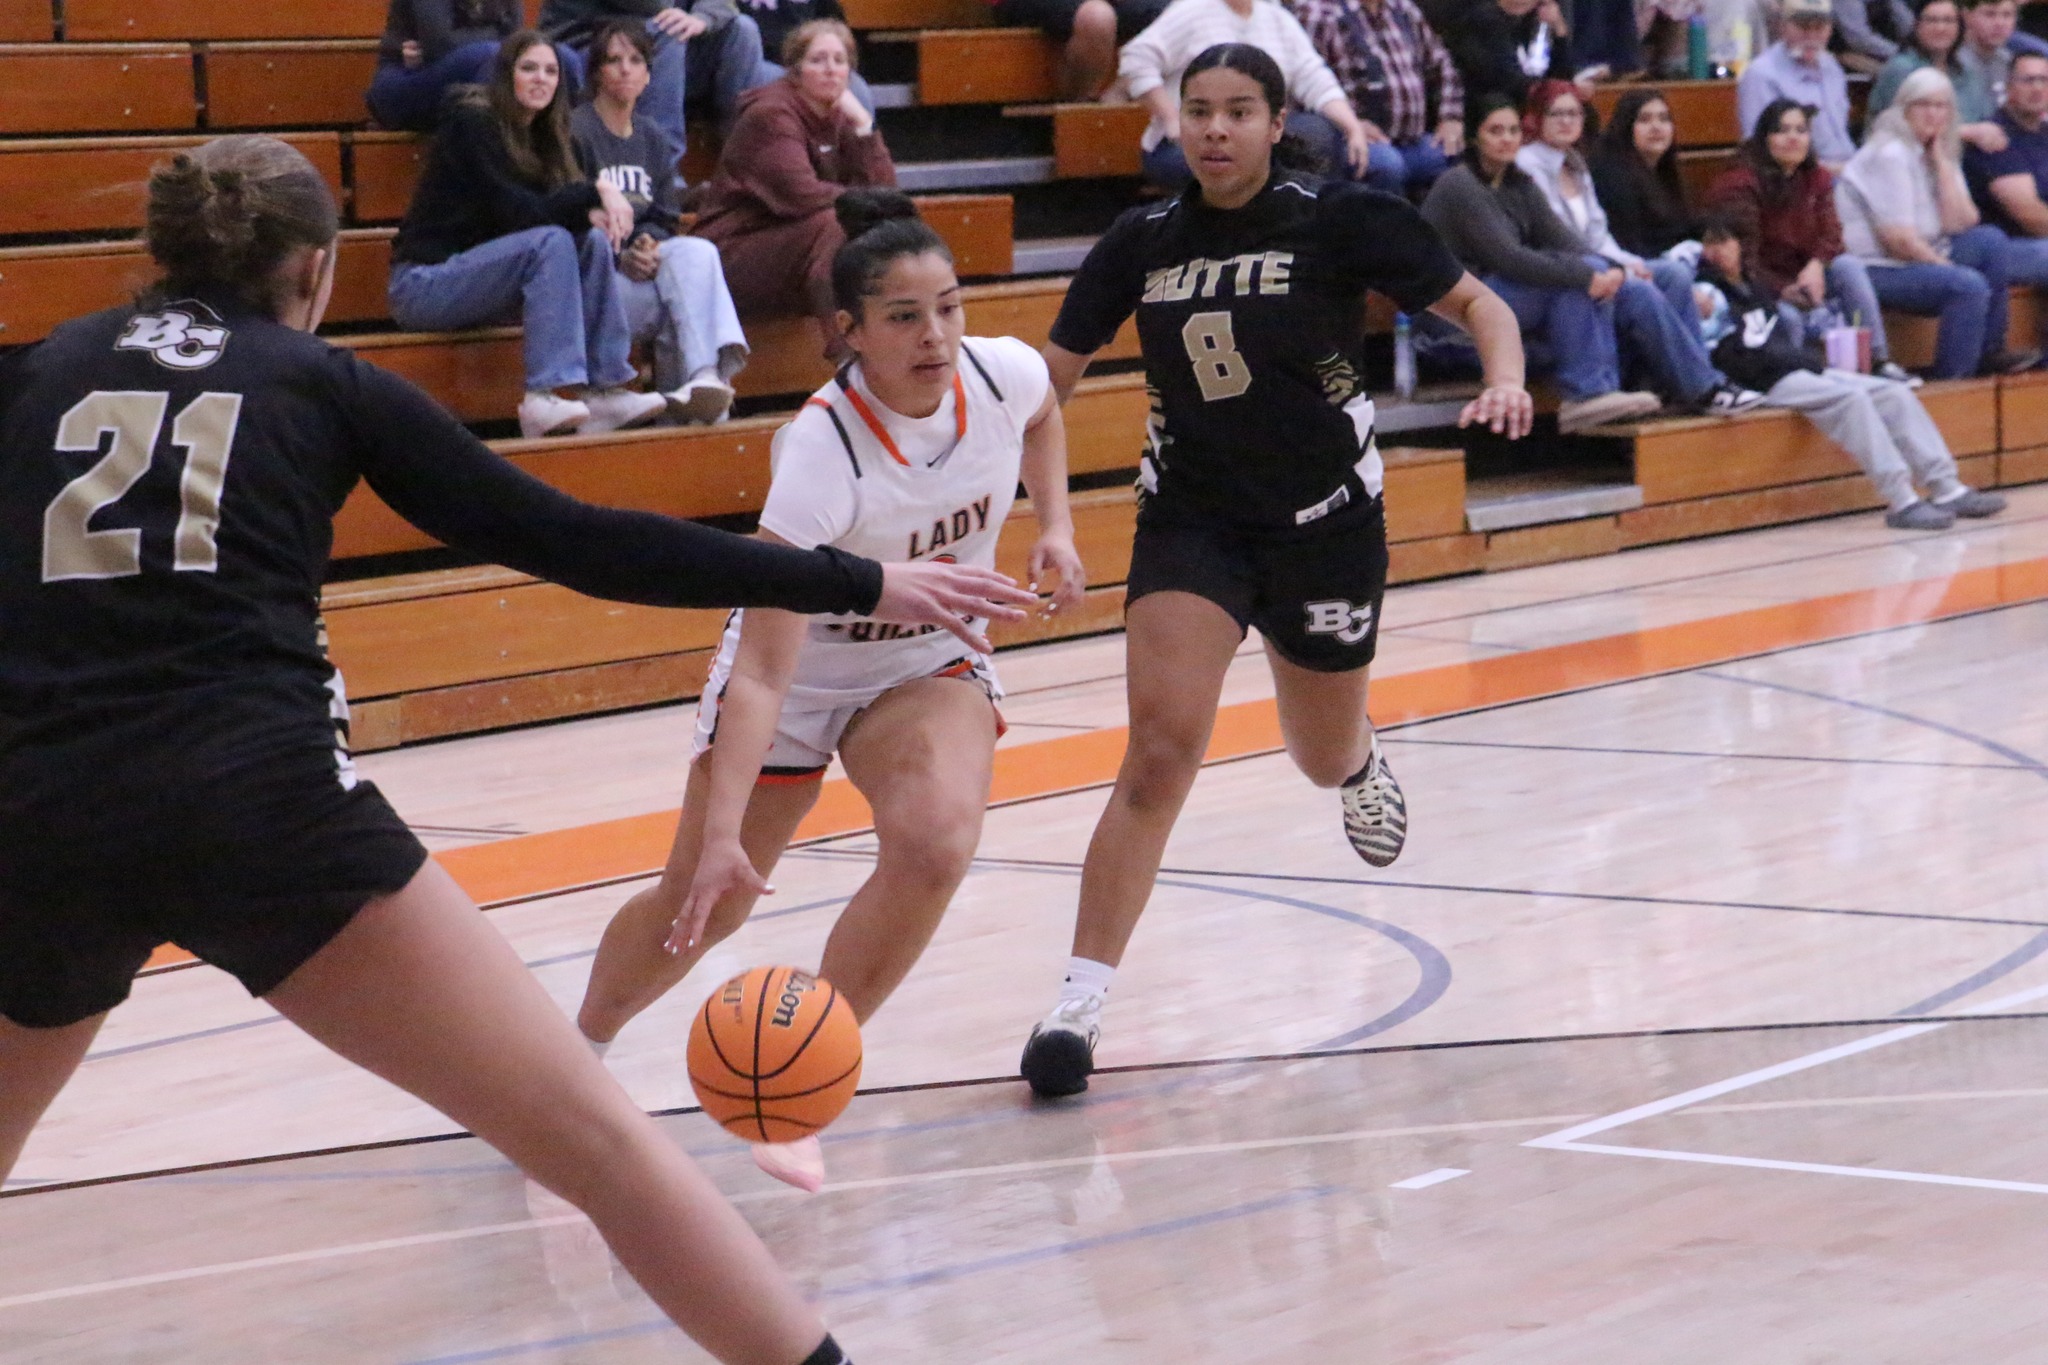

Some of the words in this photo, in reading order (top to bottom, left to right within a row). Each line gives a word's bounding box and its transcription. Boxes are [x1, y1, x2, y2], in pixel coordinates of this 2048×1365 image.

[114, 308, 231, 371] BC
[1182, 311, 1252, 402] 8
[42, 390, 244, 583] 21
[908, 493, 992, 559] LADY
[1303, 599, 1372, 645] BC
[771, 969, 816, 1028] son
